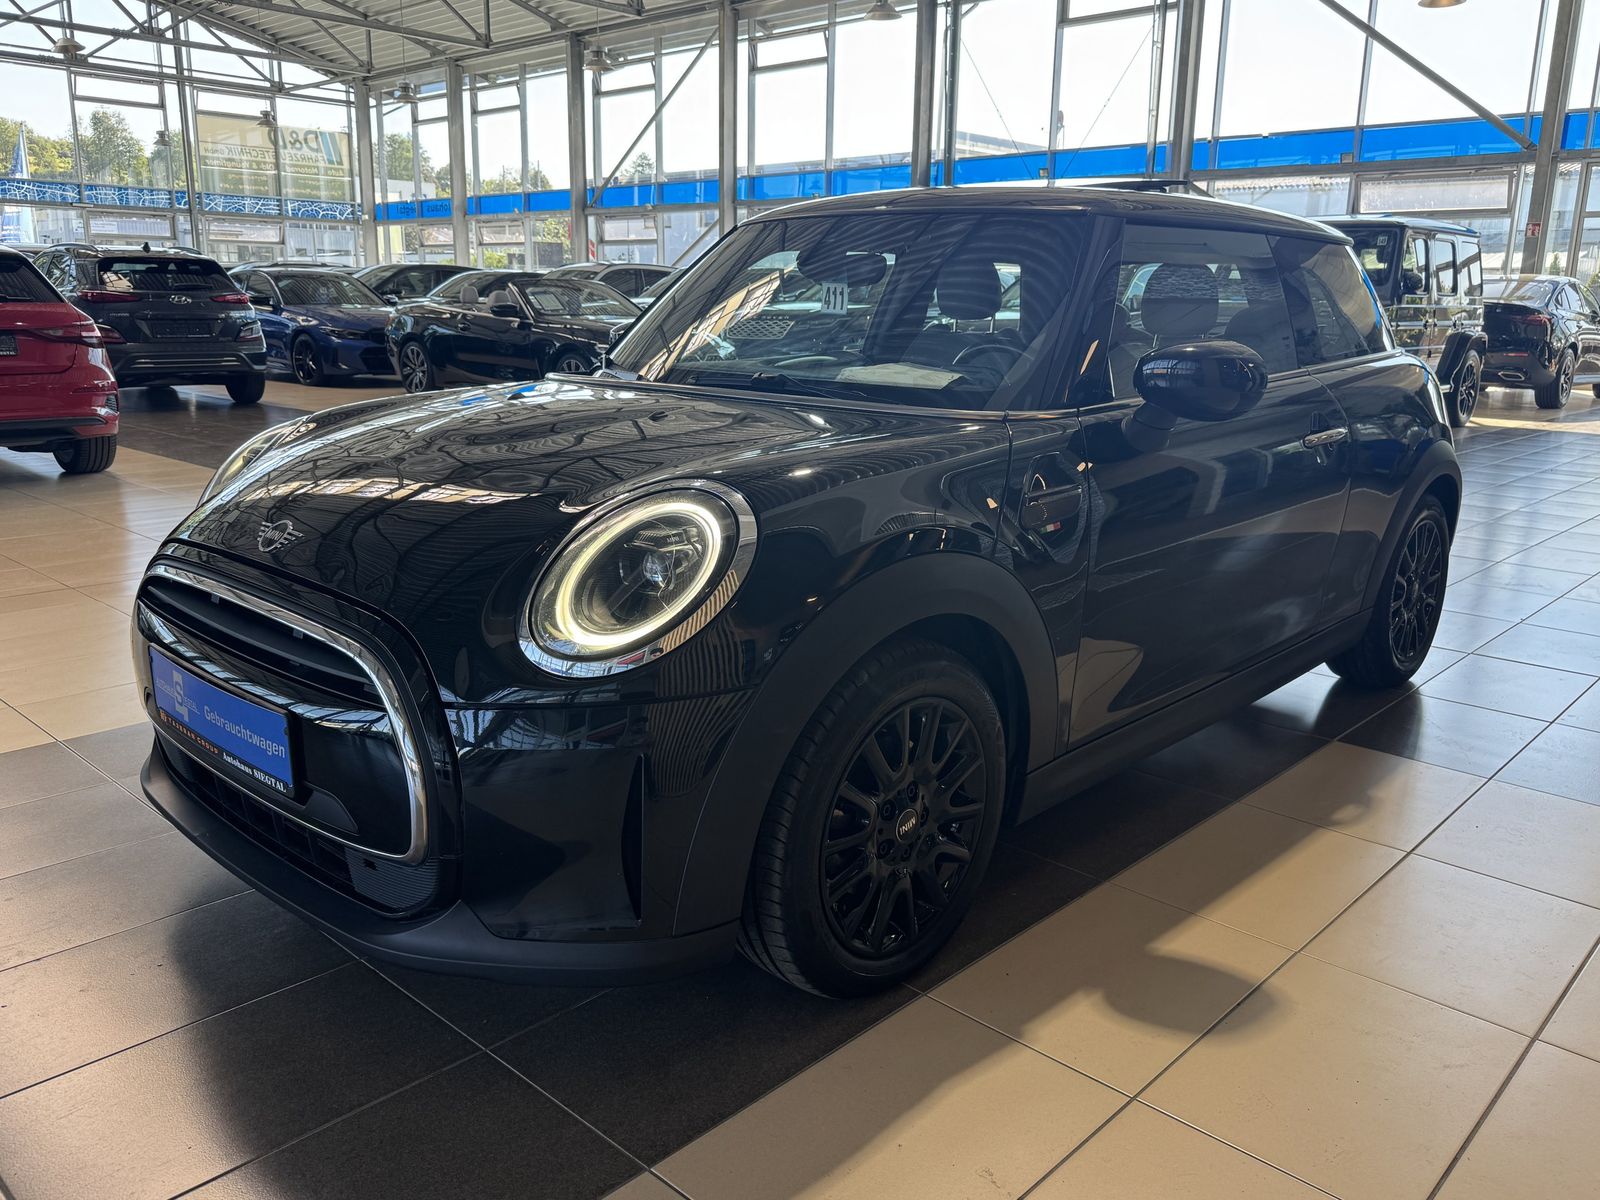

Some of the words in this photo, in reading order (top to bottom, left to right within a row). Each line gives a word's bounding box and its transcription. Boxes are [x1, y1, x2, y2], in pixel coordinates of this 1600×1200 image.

[824, 287, 844, 310] 411
[265, 529, 283, 540] MINI
[204, 705, 286, 758] Gebrauchtwagen
[223, 752, 252, 775] Autohaus
[253, 768, 287, 793] SIEGTAL
[900, 816, 916, 835] MINI
